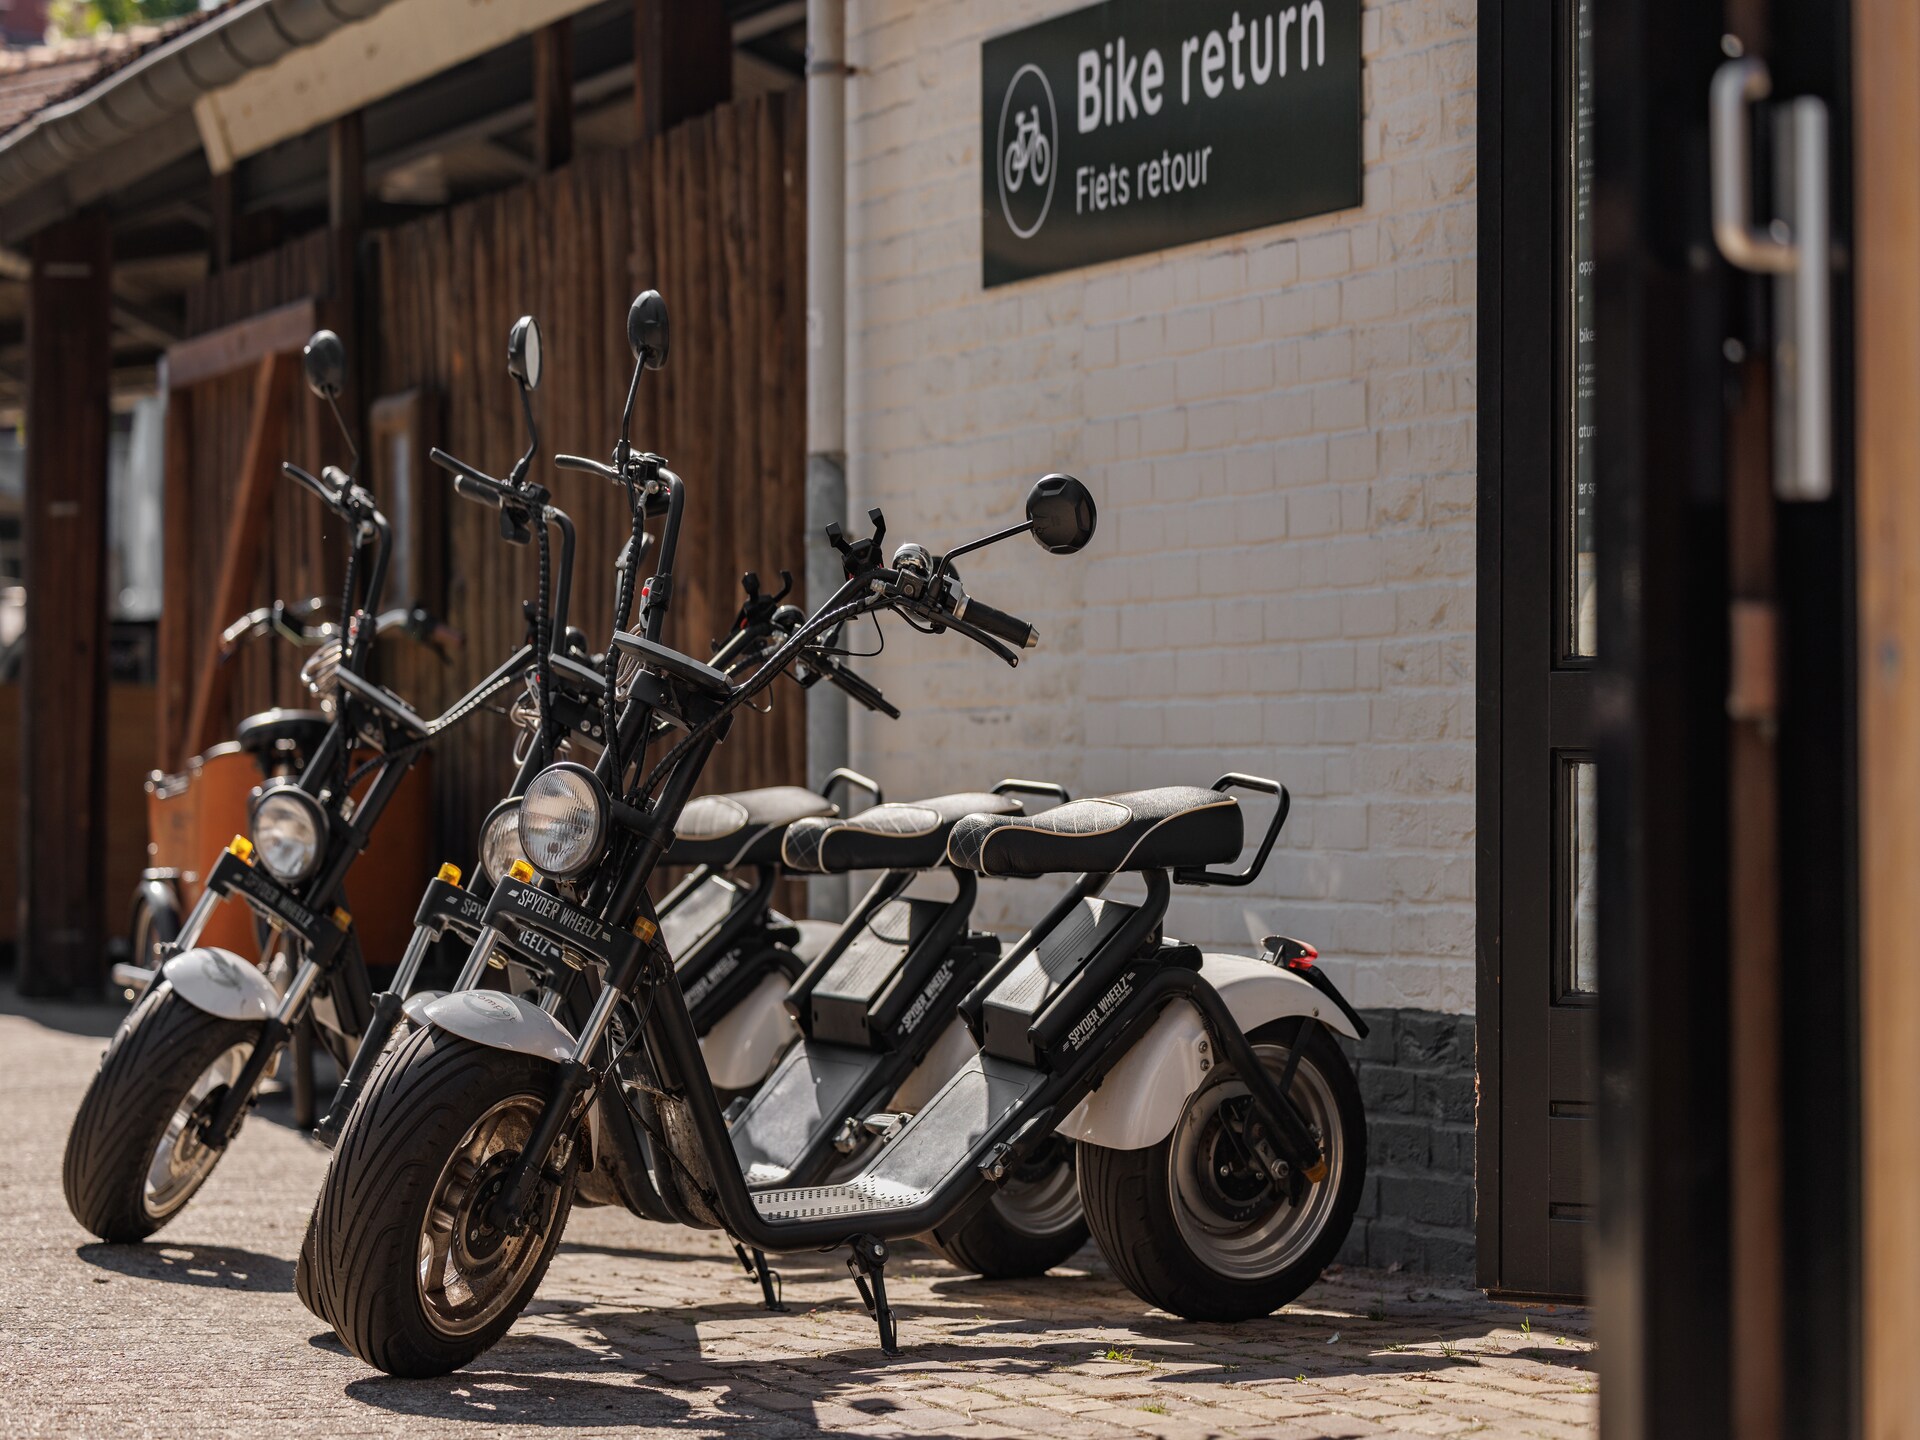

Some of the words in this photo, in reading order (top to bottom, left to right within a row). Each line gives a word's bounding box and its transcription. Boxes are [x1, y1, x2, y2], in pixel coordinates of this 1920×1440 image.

[1077, 36, 1165, 135] Bike
[1180, 0, 1325, 106] return
[1076, 163, 1130, 215] Fiets
[1136, 146, 1213, 200] retour
[518, 889, 561, 921] SPYDER
[559, 908, 603, 940] WHEELZ
[1068, 1008, 1100, 1046] SPYDER
[1097, 976, 1129, 1013] WHEELZ
